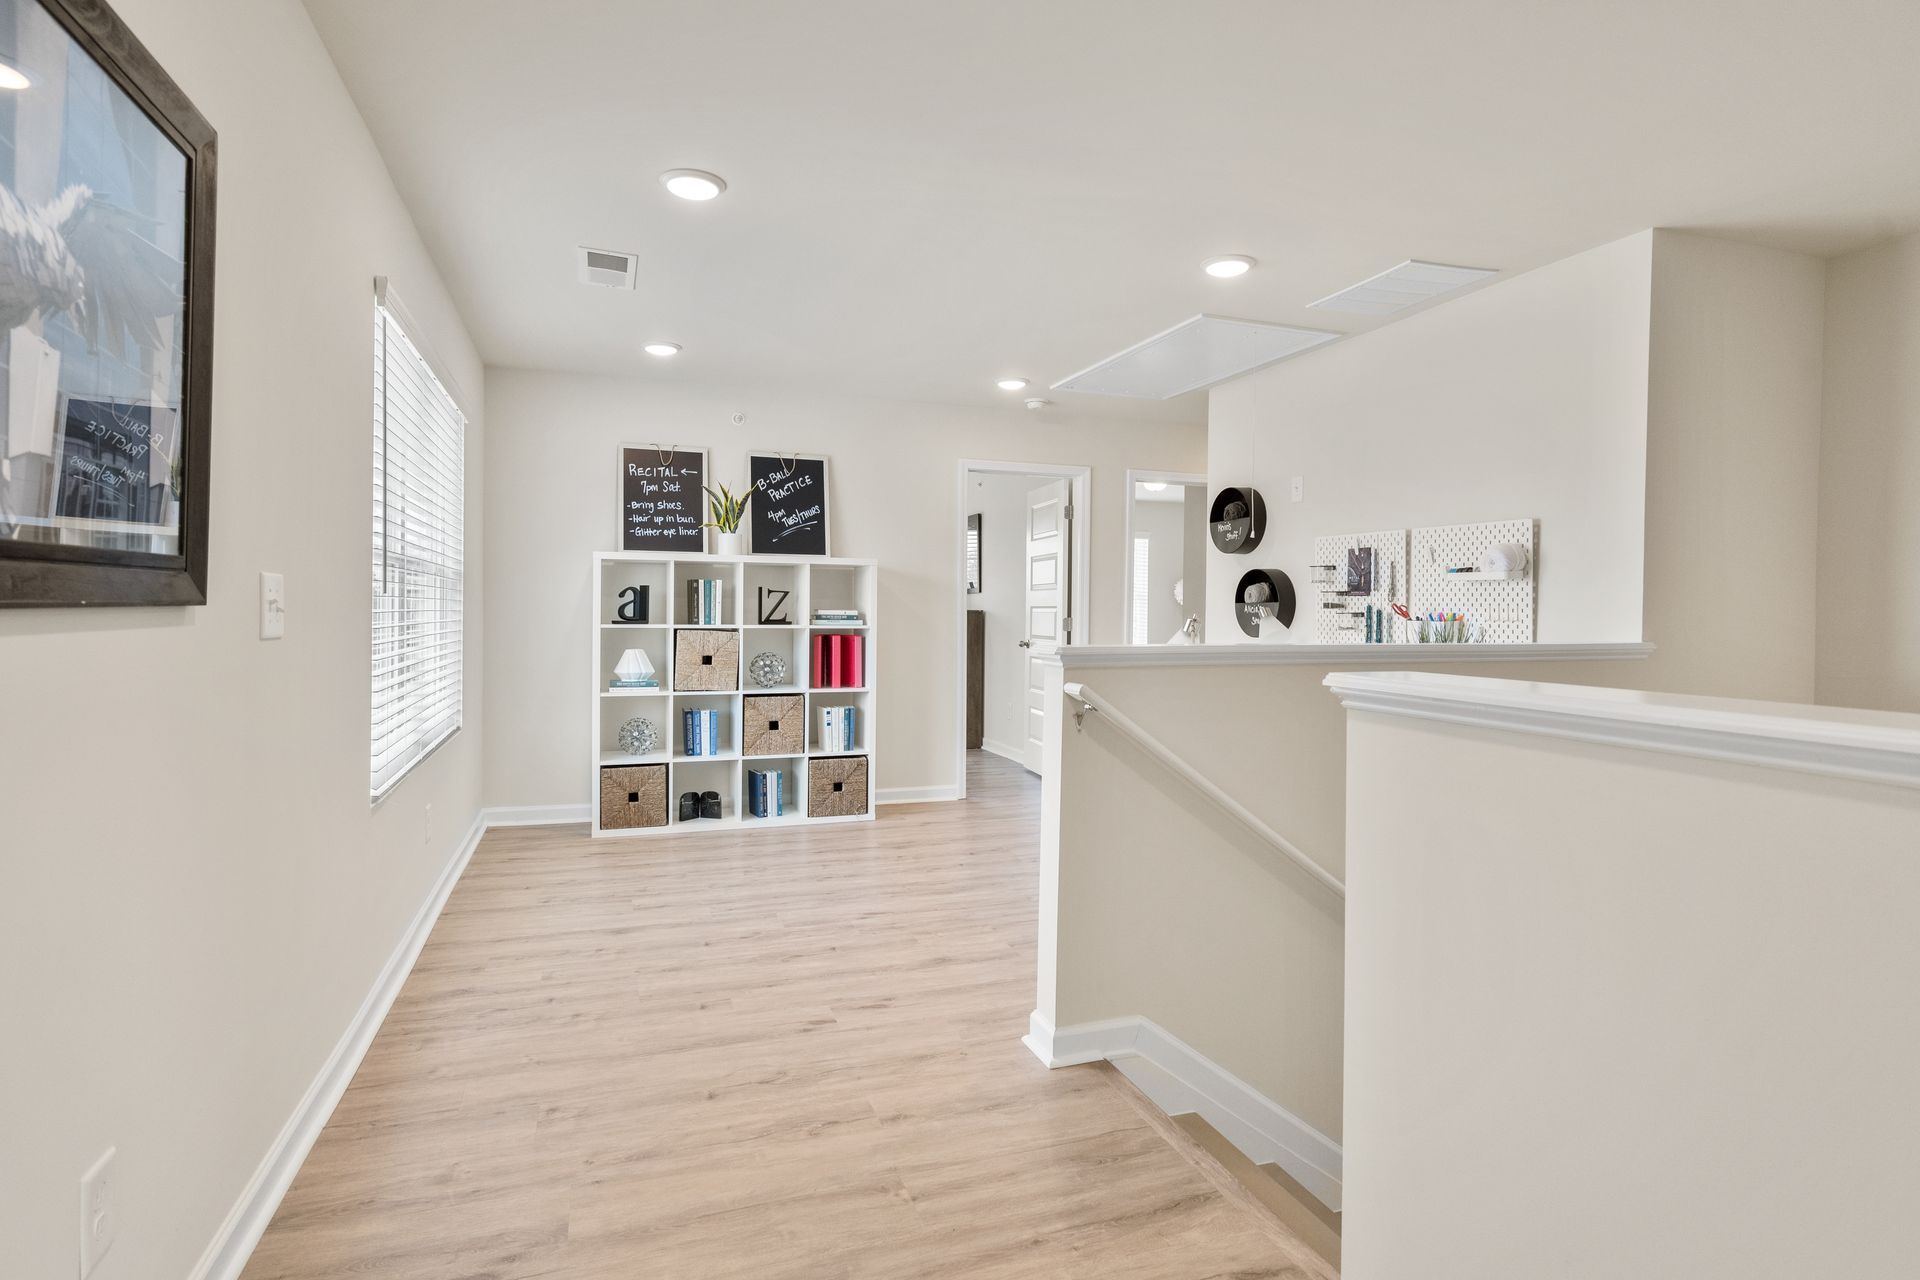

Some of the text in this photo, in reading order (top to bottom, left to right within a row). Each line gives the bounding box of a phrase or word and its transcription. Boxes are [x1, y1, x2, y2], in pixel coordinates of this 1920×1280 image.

[628, 463, 679, 478] RECITAL
[757, 468, 790, 491] B-BALL
[640, 480, 659, 496] 7pm
[767, 475, 813, 502] PRACTICE
[653, 516, 664, 526] up
[665, 515, 675, 523] in
[662, 528, 677, 538] eye
